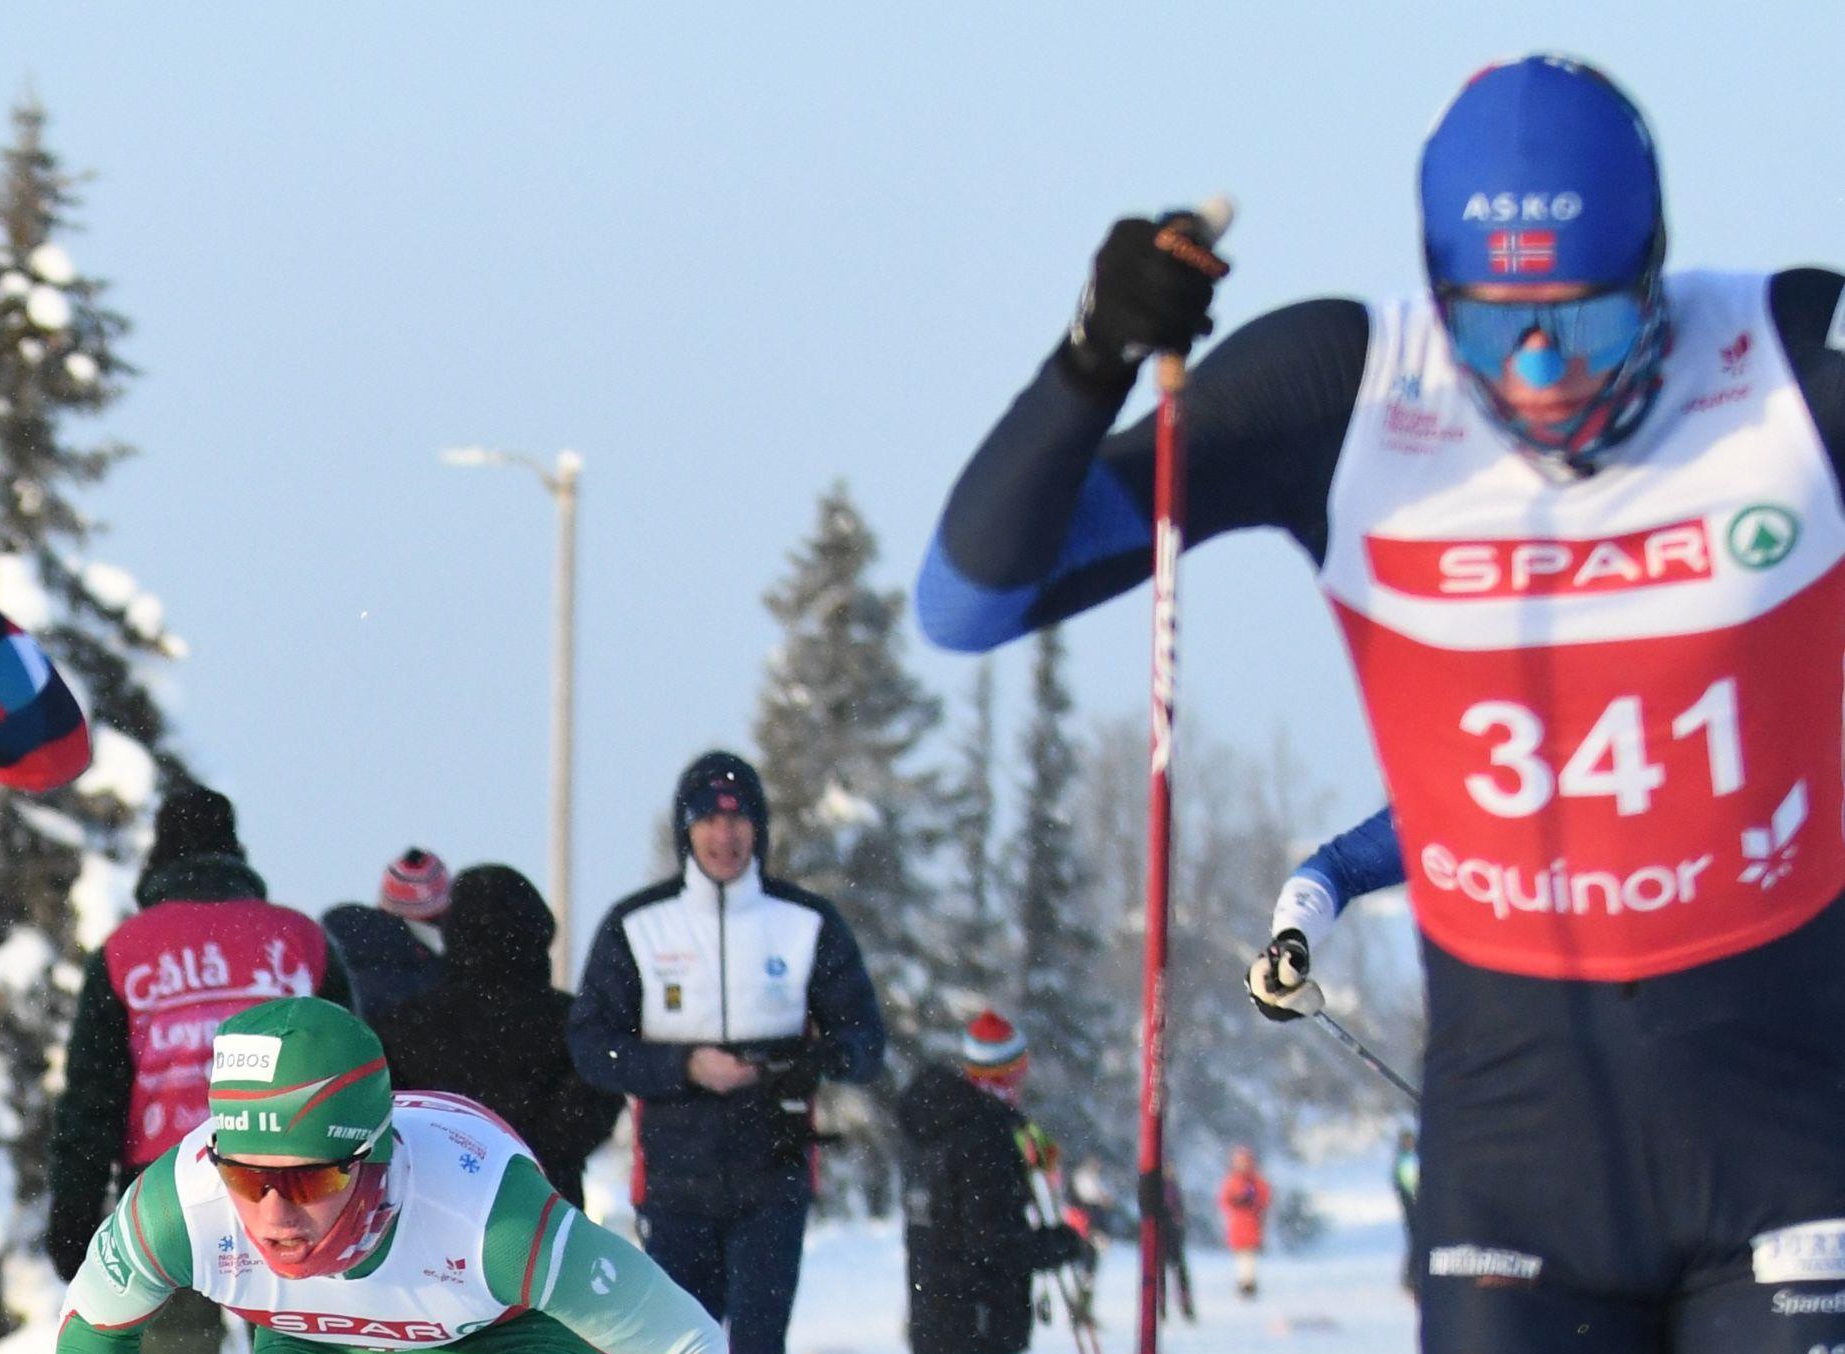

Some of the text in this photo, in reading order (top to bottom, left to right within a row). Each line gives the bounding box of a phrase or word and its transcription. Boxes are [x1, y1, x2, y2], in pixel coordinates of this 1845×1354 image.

[1462, 191, 1583, 222] ASKO
[1439, 525, 1708, 593] SPAR
[1459, 677, 1746, 818] 341
[1420, 842, 1715, 920] equinor
[270, 1314, 452, 1340] SPAR
